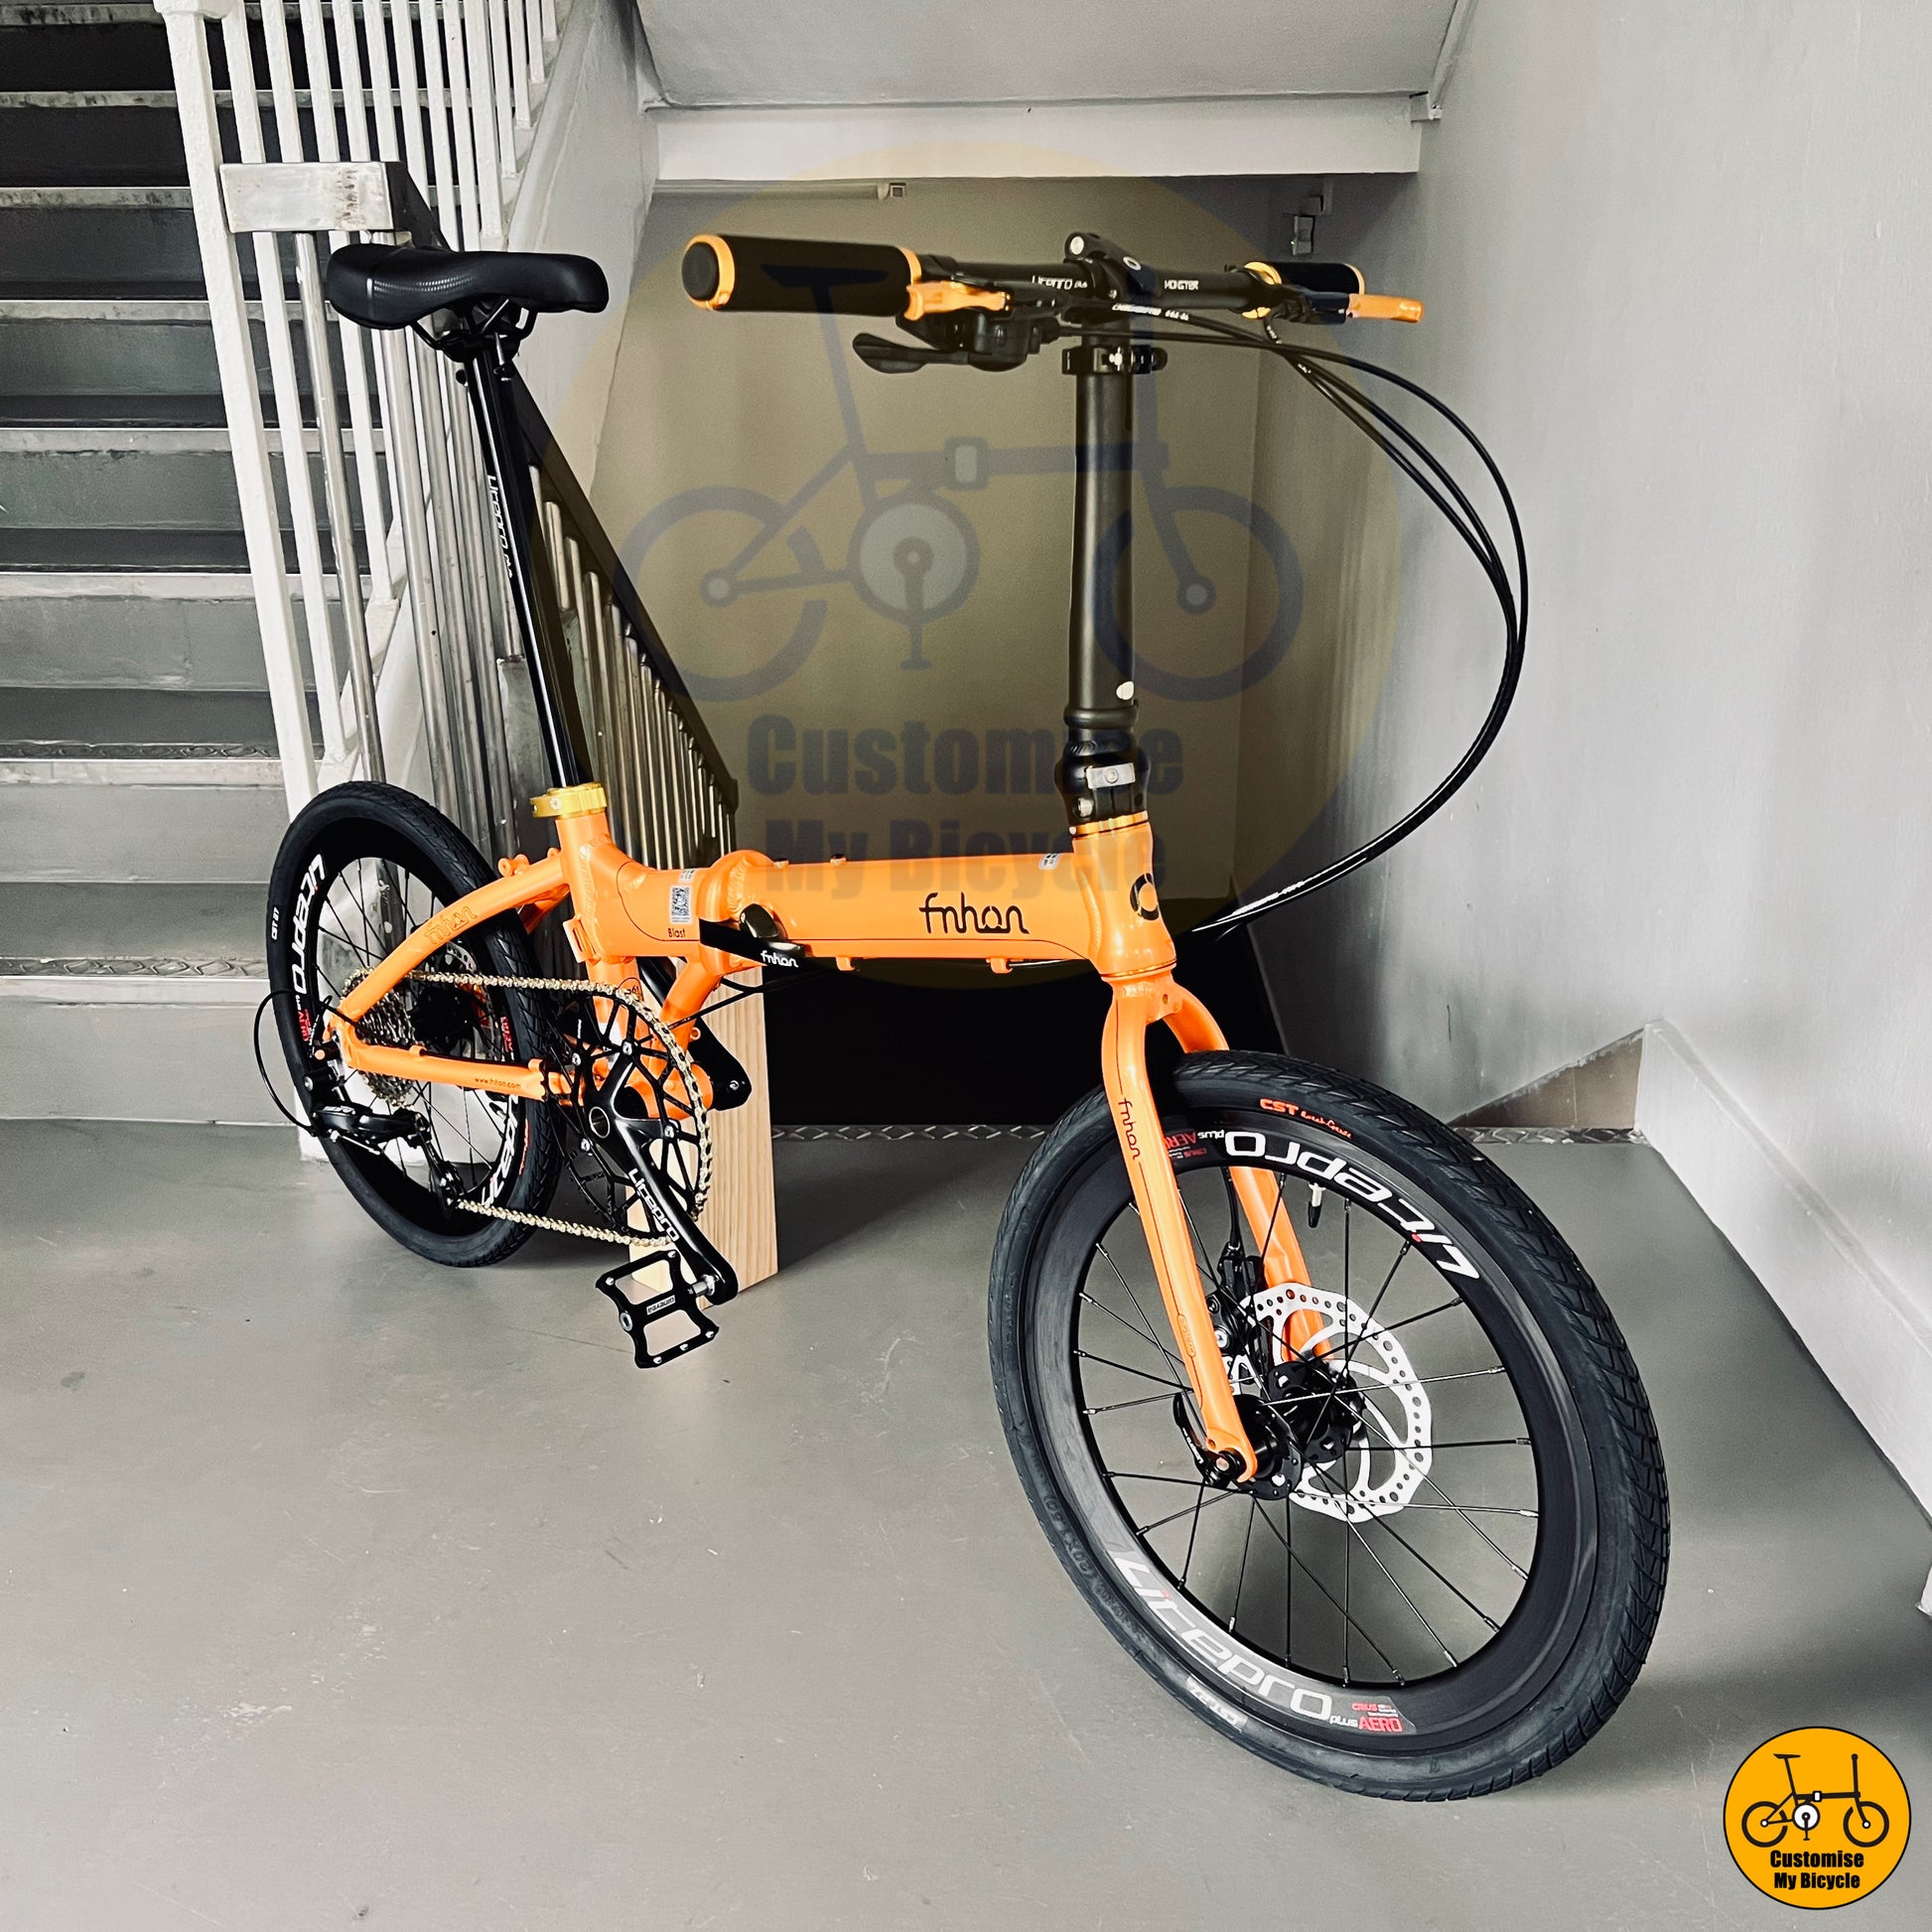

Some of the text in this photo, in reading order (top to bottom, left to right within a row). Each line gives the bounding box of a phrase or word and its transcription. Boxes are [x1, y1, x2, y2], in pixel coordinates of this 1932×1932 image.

[667, 927, 686, 938] Blast
[1259, 1097, 1300, 1117] CST
[1358, 1716, 1404, 1732] AERO
